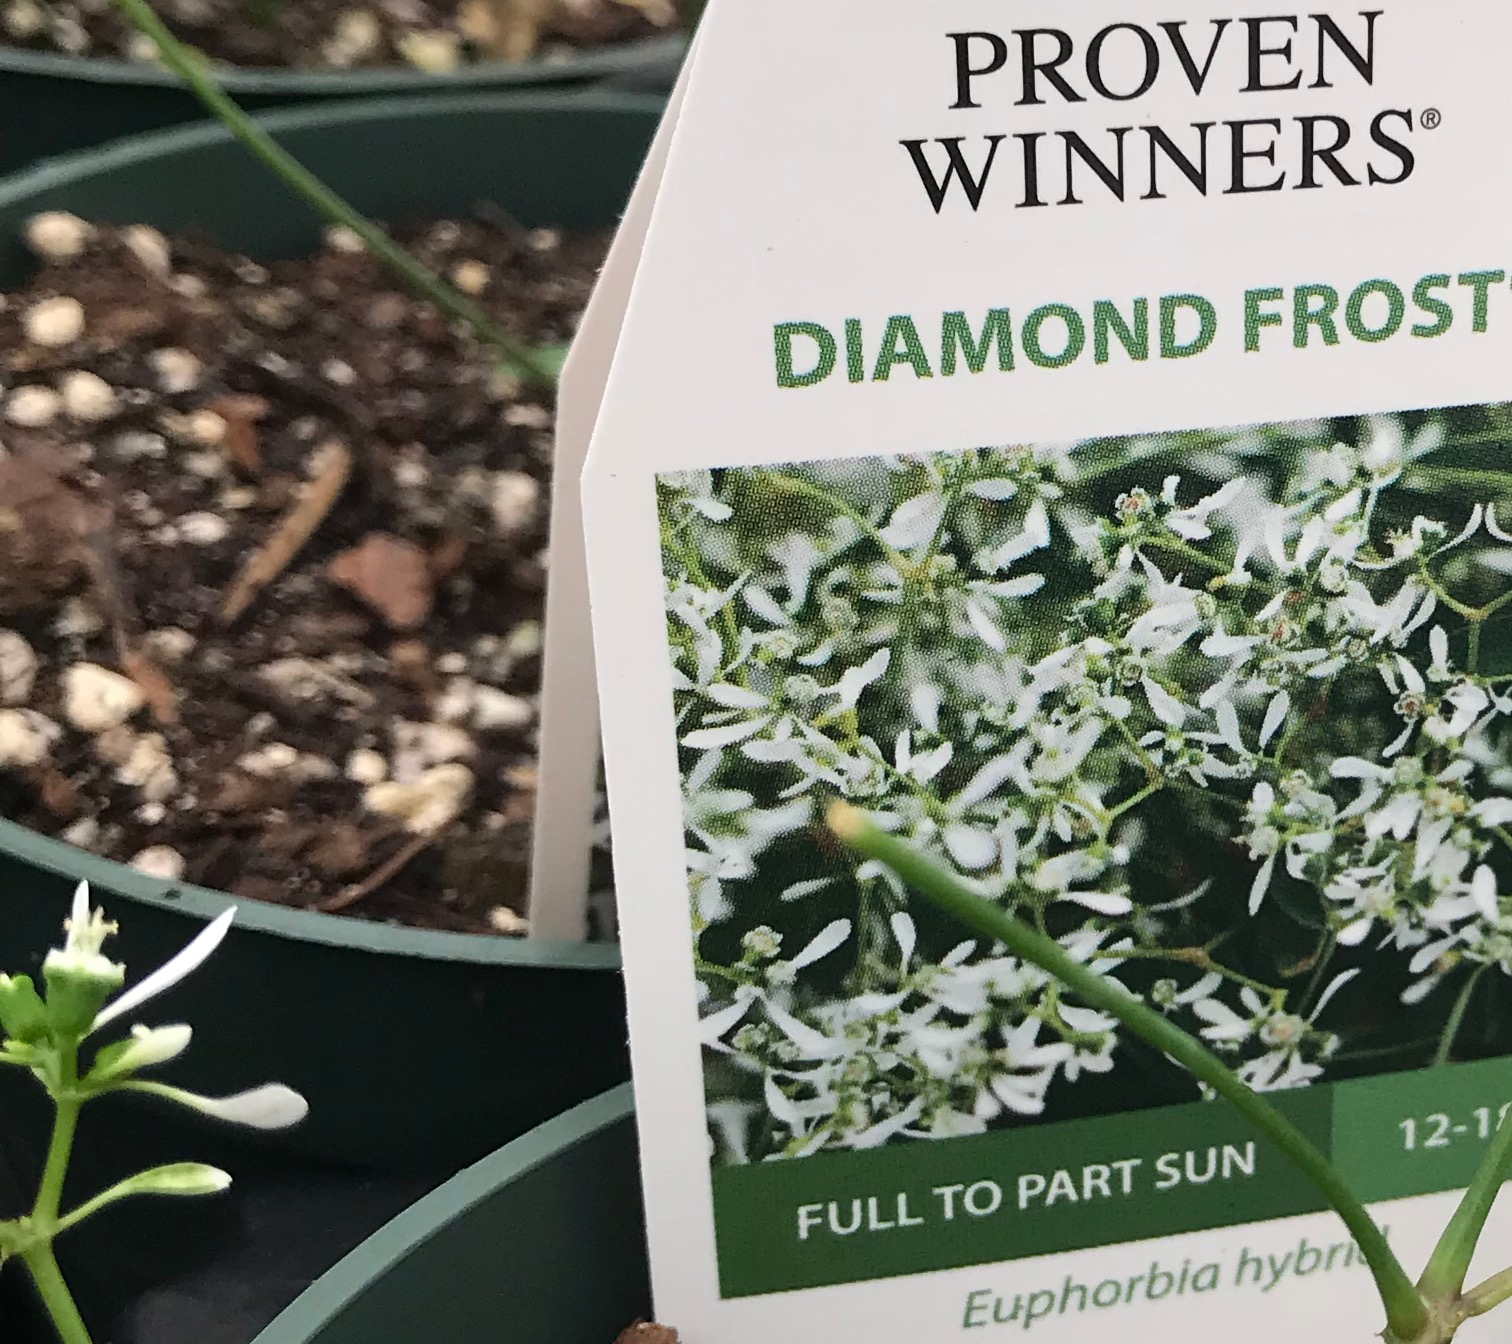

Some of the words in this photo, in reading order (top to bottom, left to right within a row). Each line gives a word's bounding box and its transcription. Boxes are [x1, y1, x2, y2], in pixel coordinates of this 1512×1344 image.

[946, 10, 1384, 110] PROVEN
[773, 293, 1217, 389] DIAMOND
[797, 1192, 924, 1240] FULL
[933, 1180, 1002, 1220] TO
[1018, 1158, 1142, 1210] PART
[1155, 1141, 1256, 1189] SUN
[962, 1260, 1220, 1330] Euphorbia
